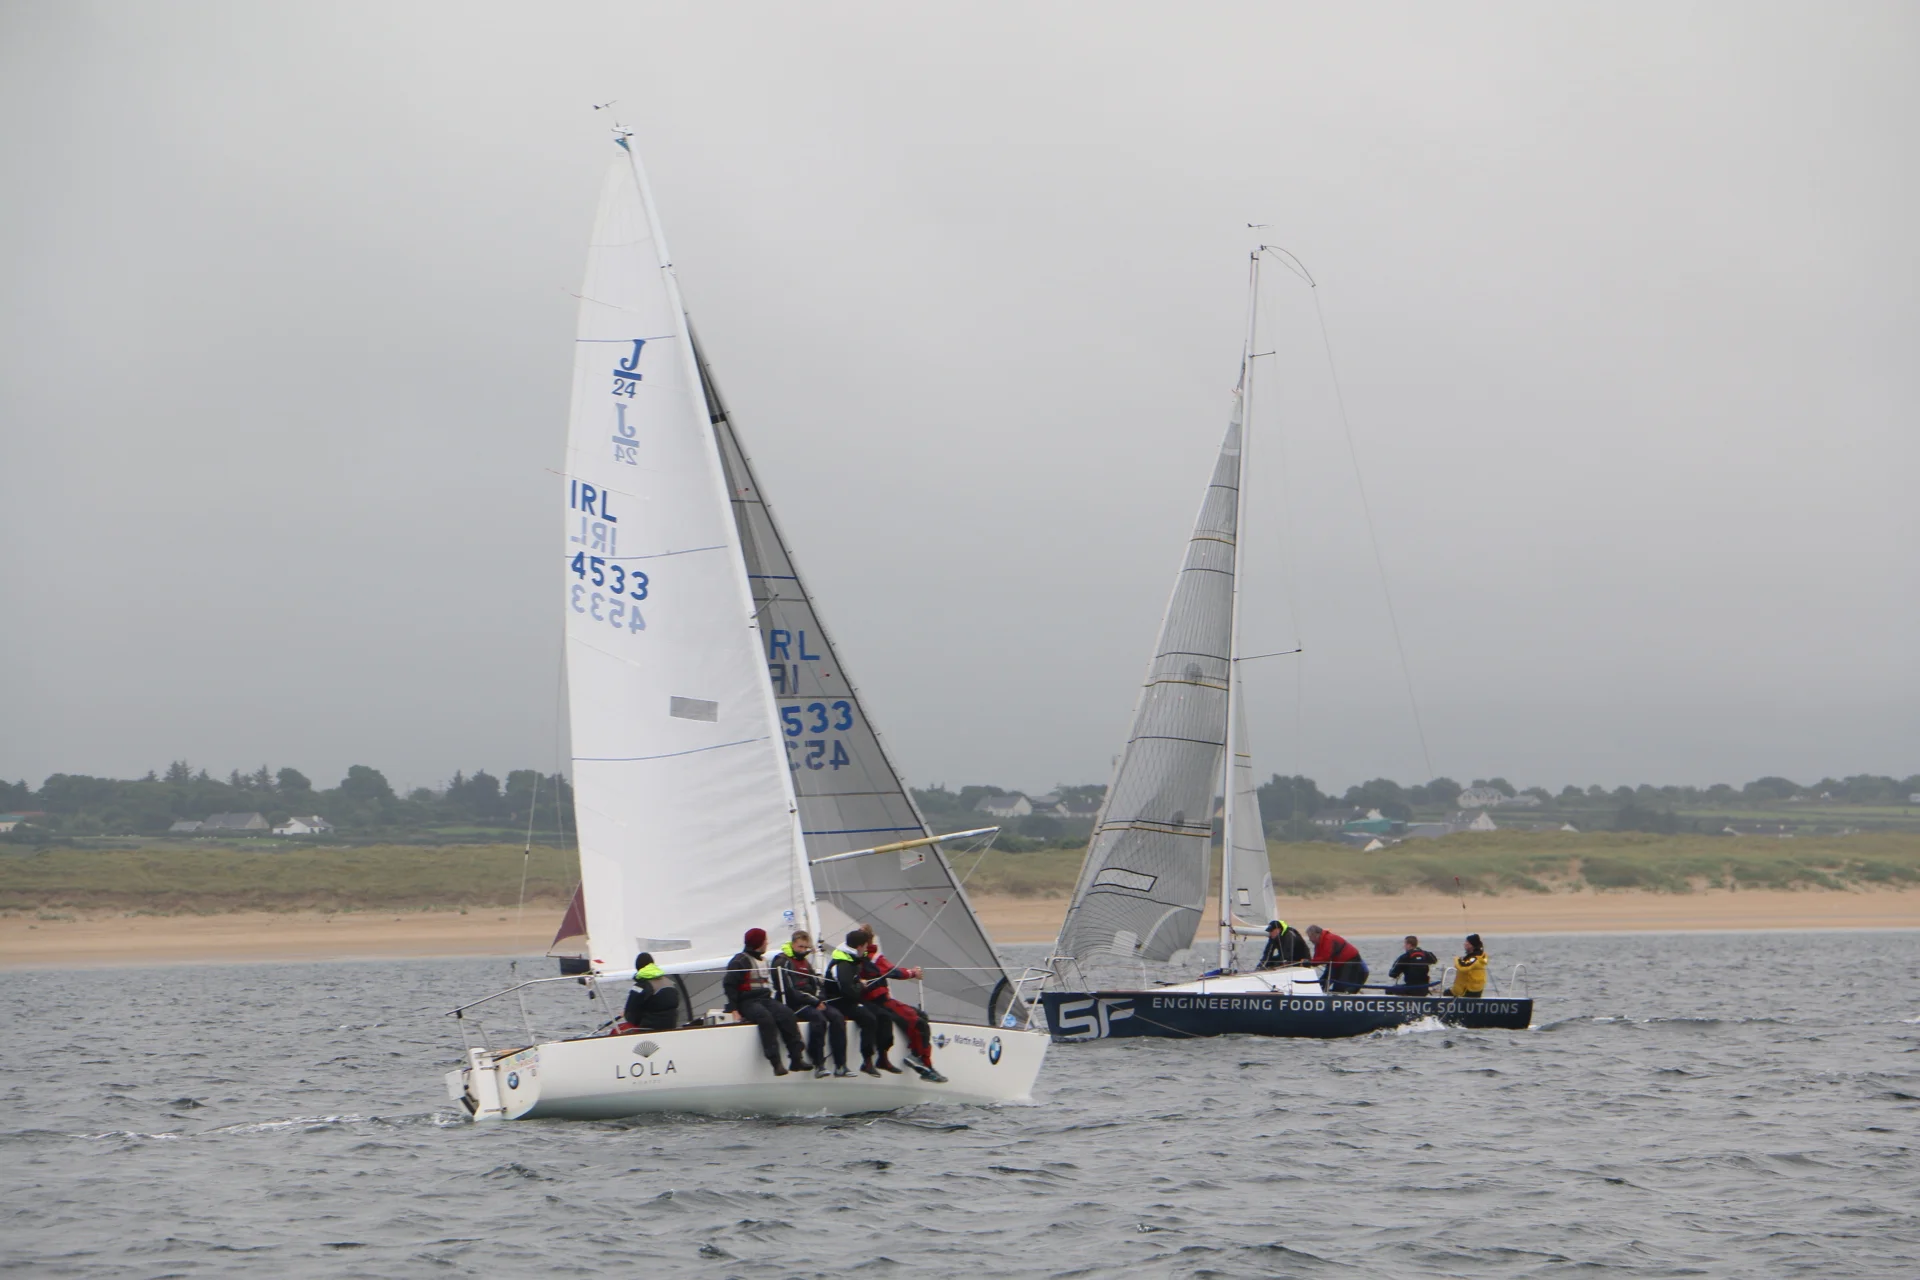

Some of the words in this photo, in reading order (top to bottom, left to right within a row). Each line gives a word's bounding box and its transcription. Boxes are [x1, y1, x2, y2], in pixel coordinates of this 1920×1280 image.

[619, 339, 646, 372] J
[611, 378, 637, 399] 24
[571, 479, 617, 523] IRL
[571, 551, 650, 601] 4533
[761, 629, 820, 661] RL
[780, 700, 853, 737] 533
[1152, 997, 1272, 1011] ENGINEERING
[1280, 999, 1325, 1012] FOOD
[1332, 1000, 1432, 1014] PROCESSING
[1438, 1001, 1519, 1015] SOLUTIONS
[616, 1060, 677, 1079] LOLA
